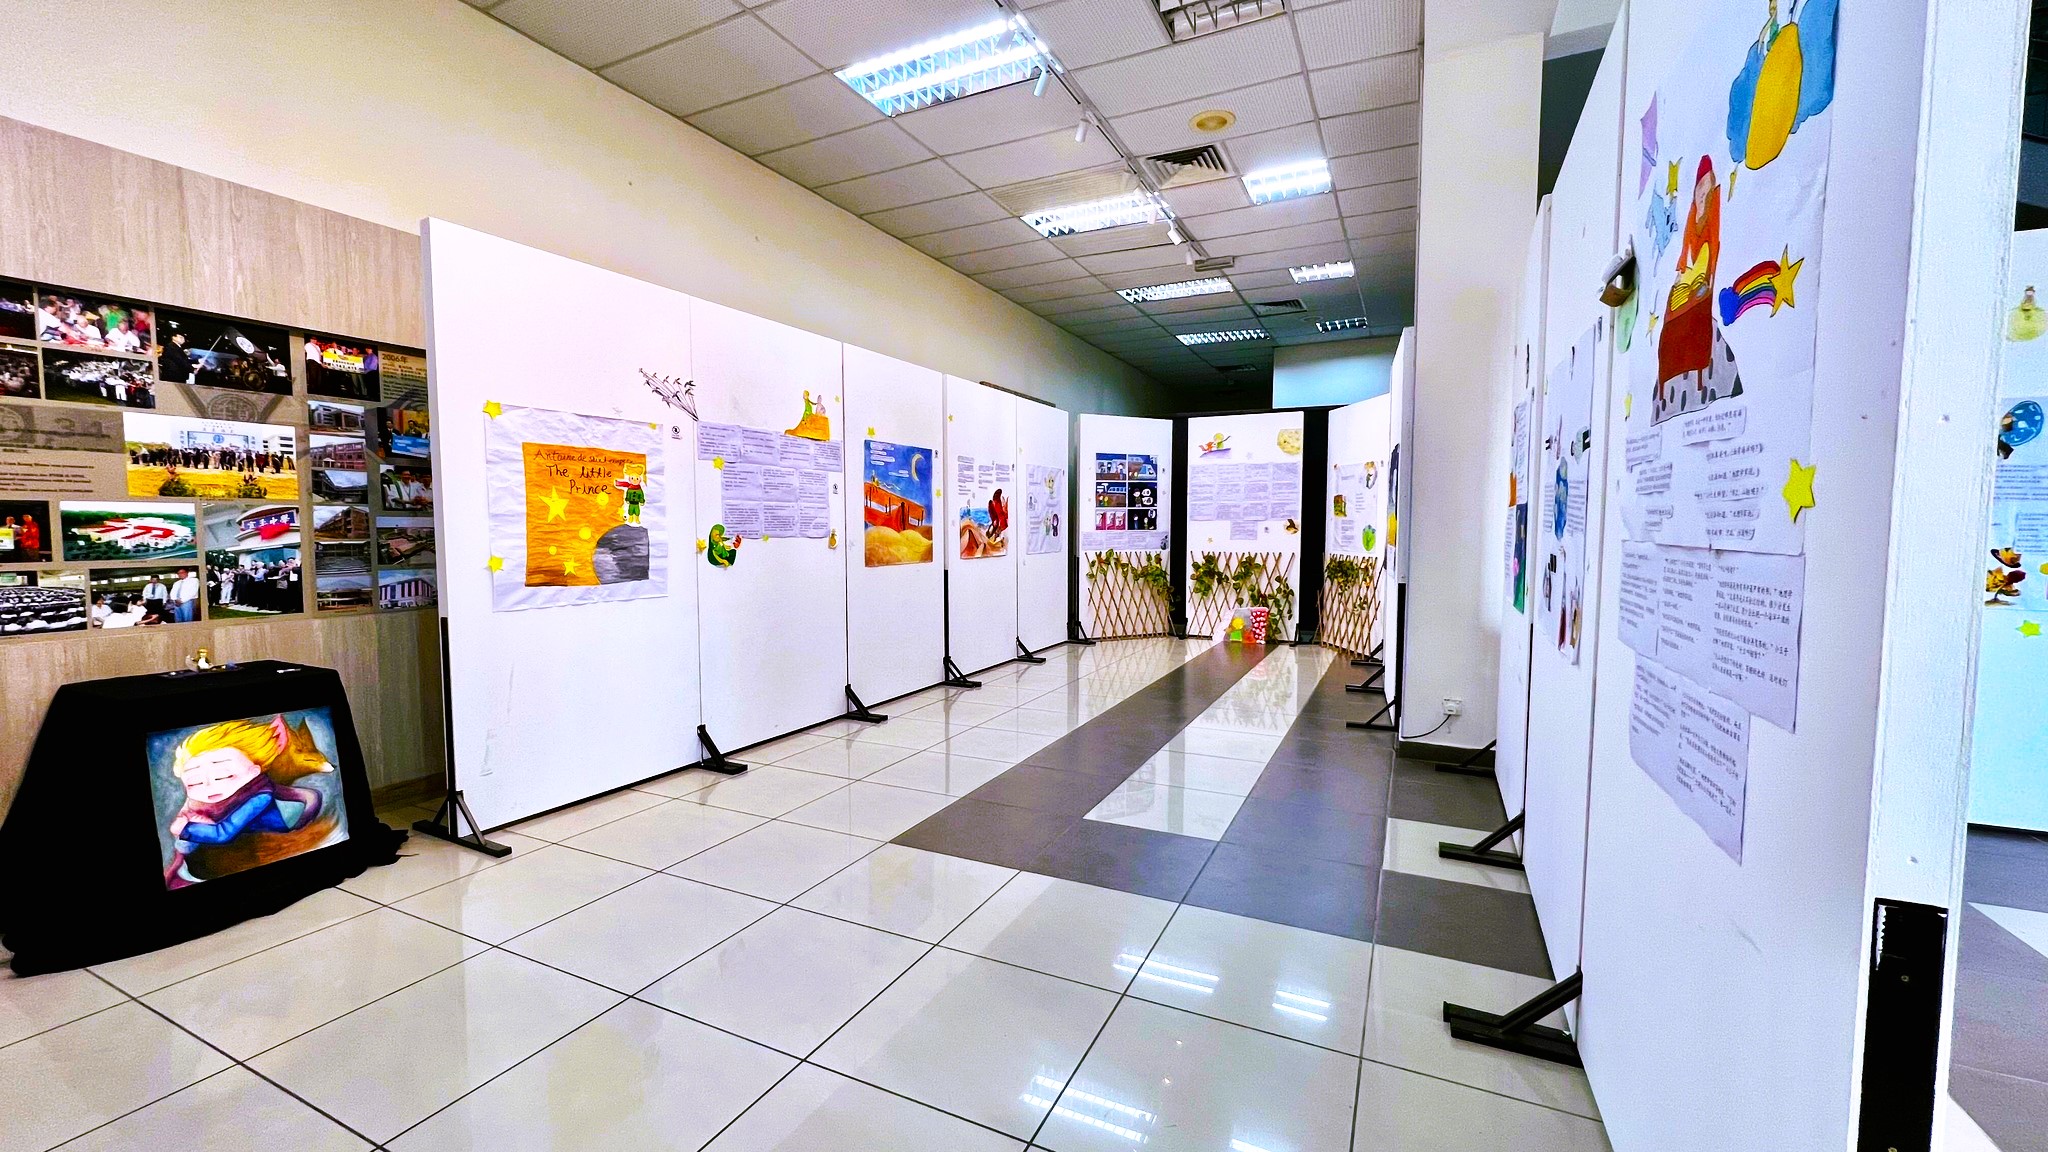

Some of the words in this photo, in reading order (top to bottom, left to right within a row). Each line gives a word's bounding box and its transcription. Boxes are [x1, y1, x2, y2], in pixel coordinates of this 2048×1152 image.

[546, 464, 569, 478] The
[580, 466, 612, 479] little
[569, 479, 612, 495] Prince
